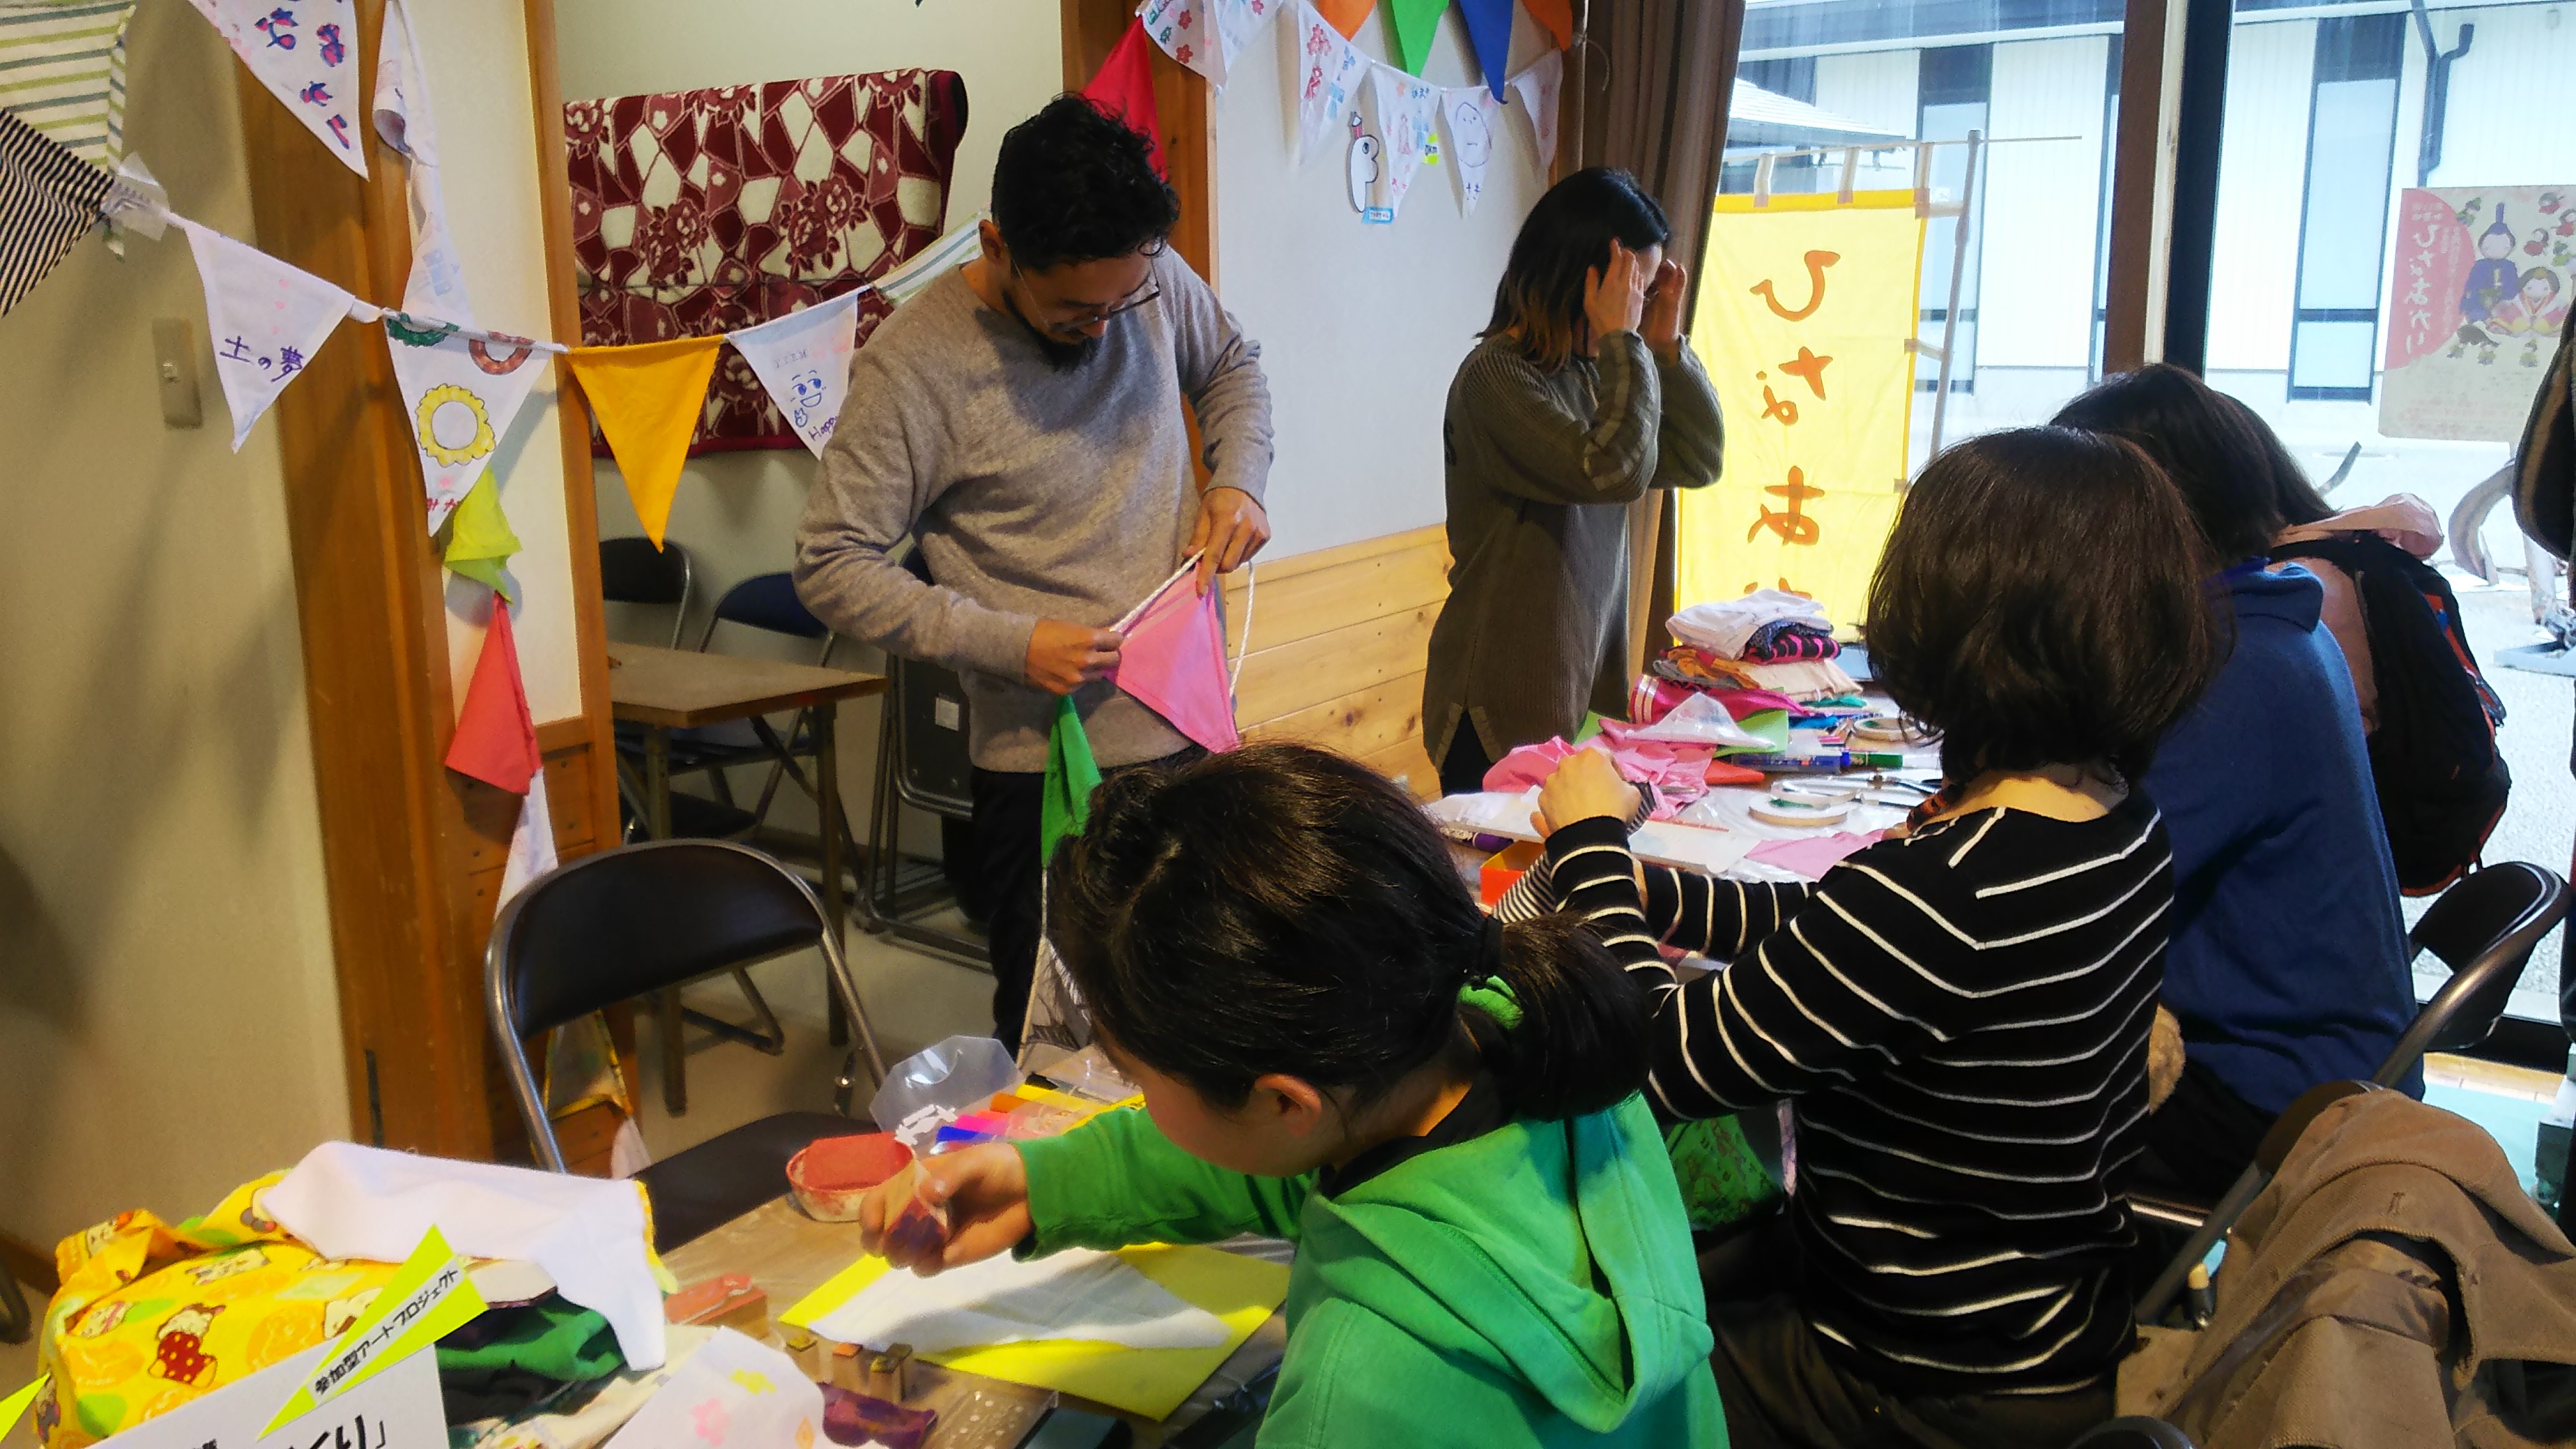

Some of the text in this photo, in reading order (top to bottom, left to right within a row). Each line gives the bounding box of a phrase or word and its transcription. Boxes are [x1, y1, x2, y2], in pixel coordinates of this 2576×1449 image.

[219, 335, 303, 382] 土の夢
[808, 416, 839, 441] Happ
